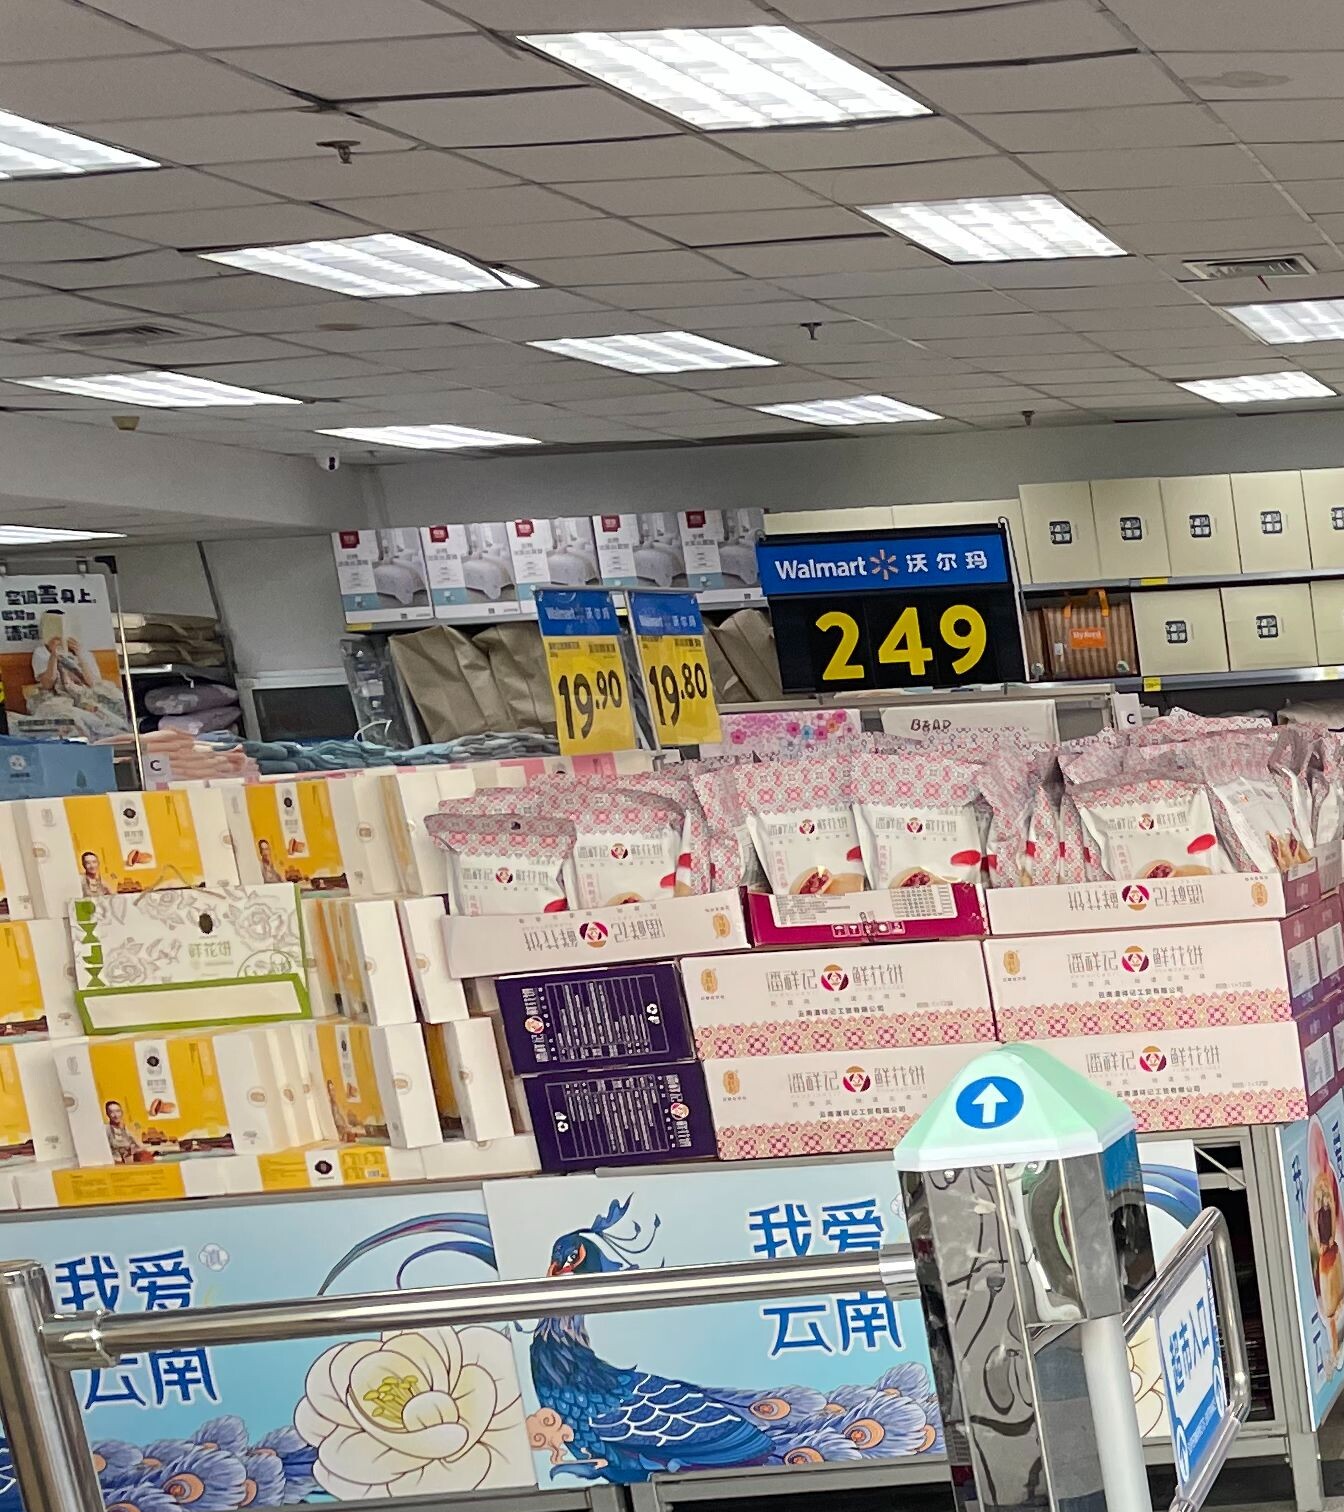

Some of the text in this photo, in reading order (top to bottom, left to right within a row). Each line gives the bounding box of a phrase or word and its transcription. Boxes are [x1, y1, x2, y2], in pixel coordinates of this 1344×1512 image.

[775, 550, 988, 580] Walmart 沃尔玛
[815, 604, 987, 681] 249
[558, 670, 622, 740] 19.90
[649, 662, 708, 728] 19.80
[1126, 714, 1137, 725] C
[150, 759, 162, 772] C
[851, 962, 905, 987] 鲜花饼
[1152, 945, 1204, 969] 鲜花饼
[873, 1064, 928, 1089] 鲜花饼
[1170, 1045, 1222, 1067] 鲜花饼
[747, 1198, 886, 1260] 我爱
[55, 1248, 194, 1312] 我爱
[762, 1291, 905, 1357] 云南
[1168, 1296, 1210, 1396] 超市入口
[85, 1348, 220, 1411] 云南
